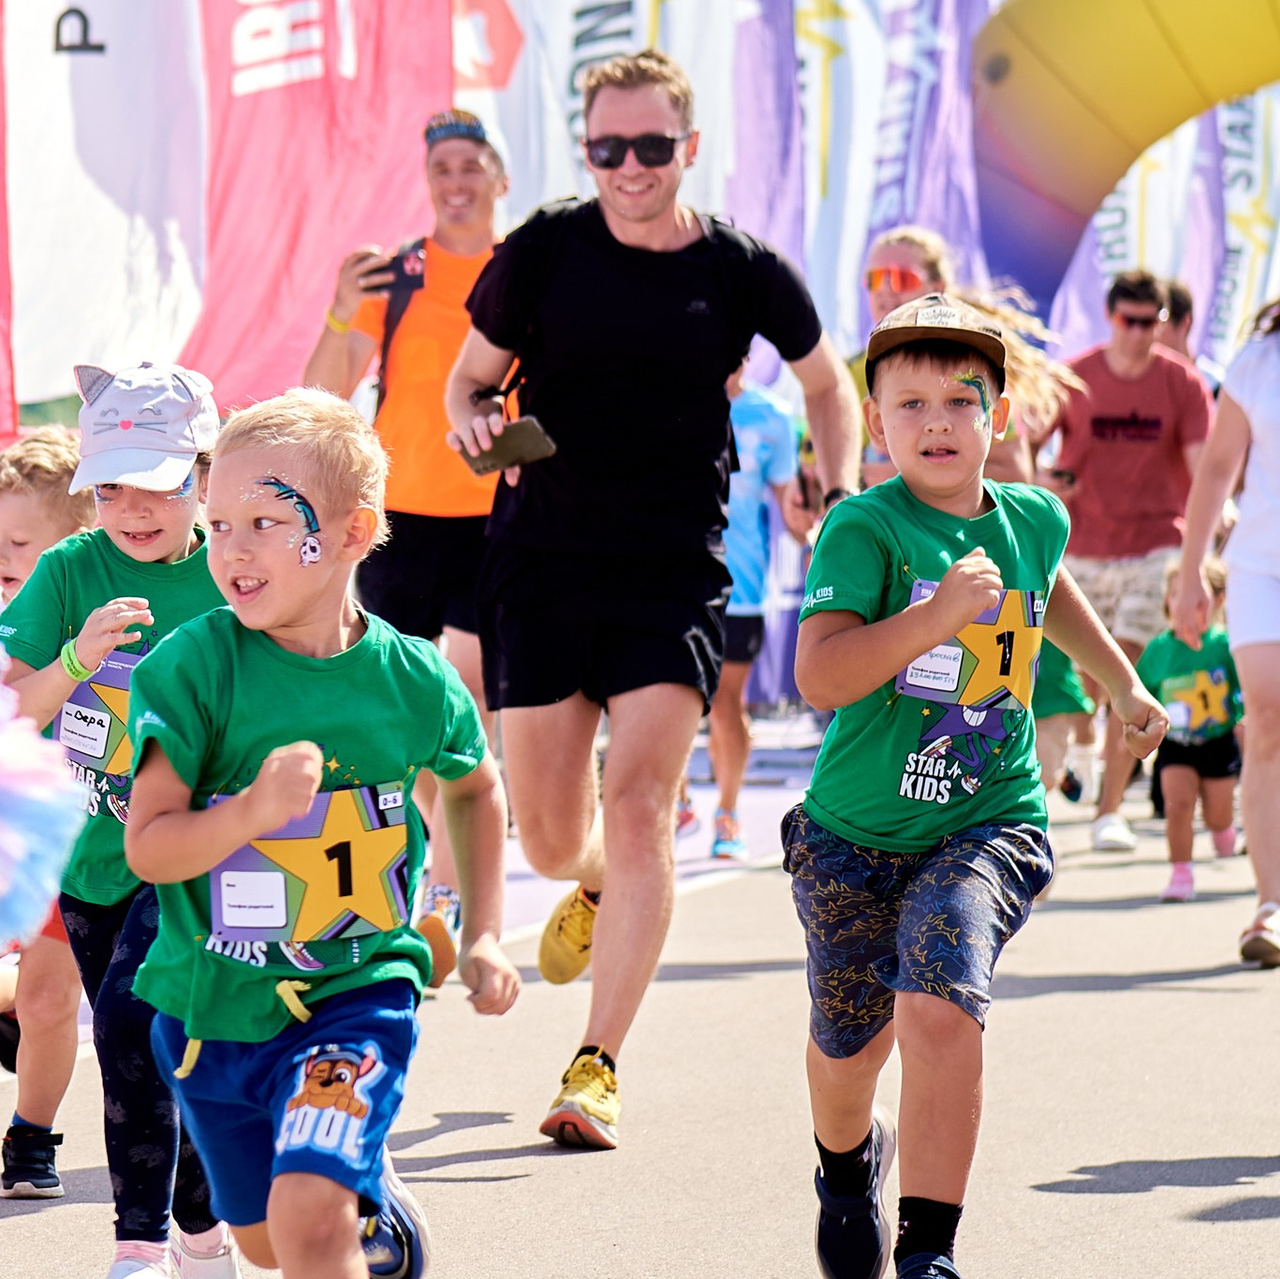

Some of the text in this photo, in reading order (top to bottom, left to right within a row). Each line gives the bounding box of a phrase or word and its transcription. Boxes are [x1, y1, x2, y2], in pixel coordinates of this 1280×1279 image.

[996, 631, 1014, 676] 1
[905, 753, 946, 778] STAR
[899, 773, 952, 804] KIDS
[324, 840, 353, 897] 1
[205, 935, 267, 968] KIDS
